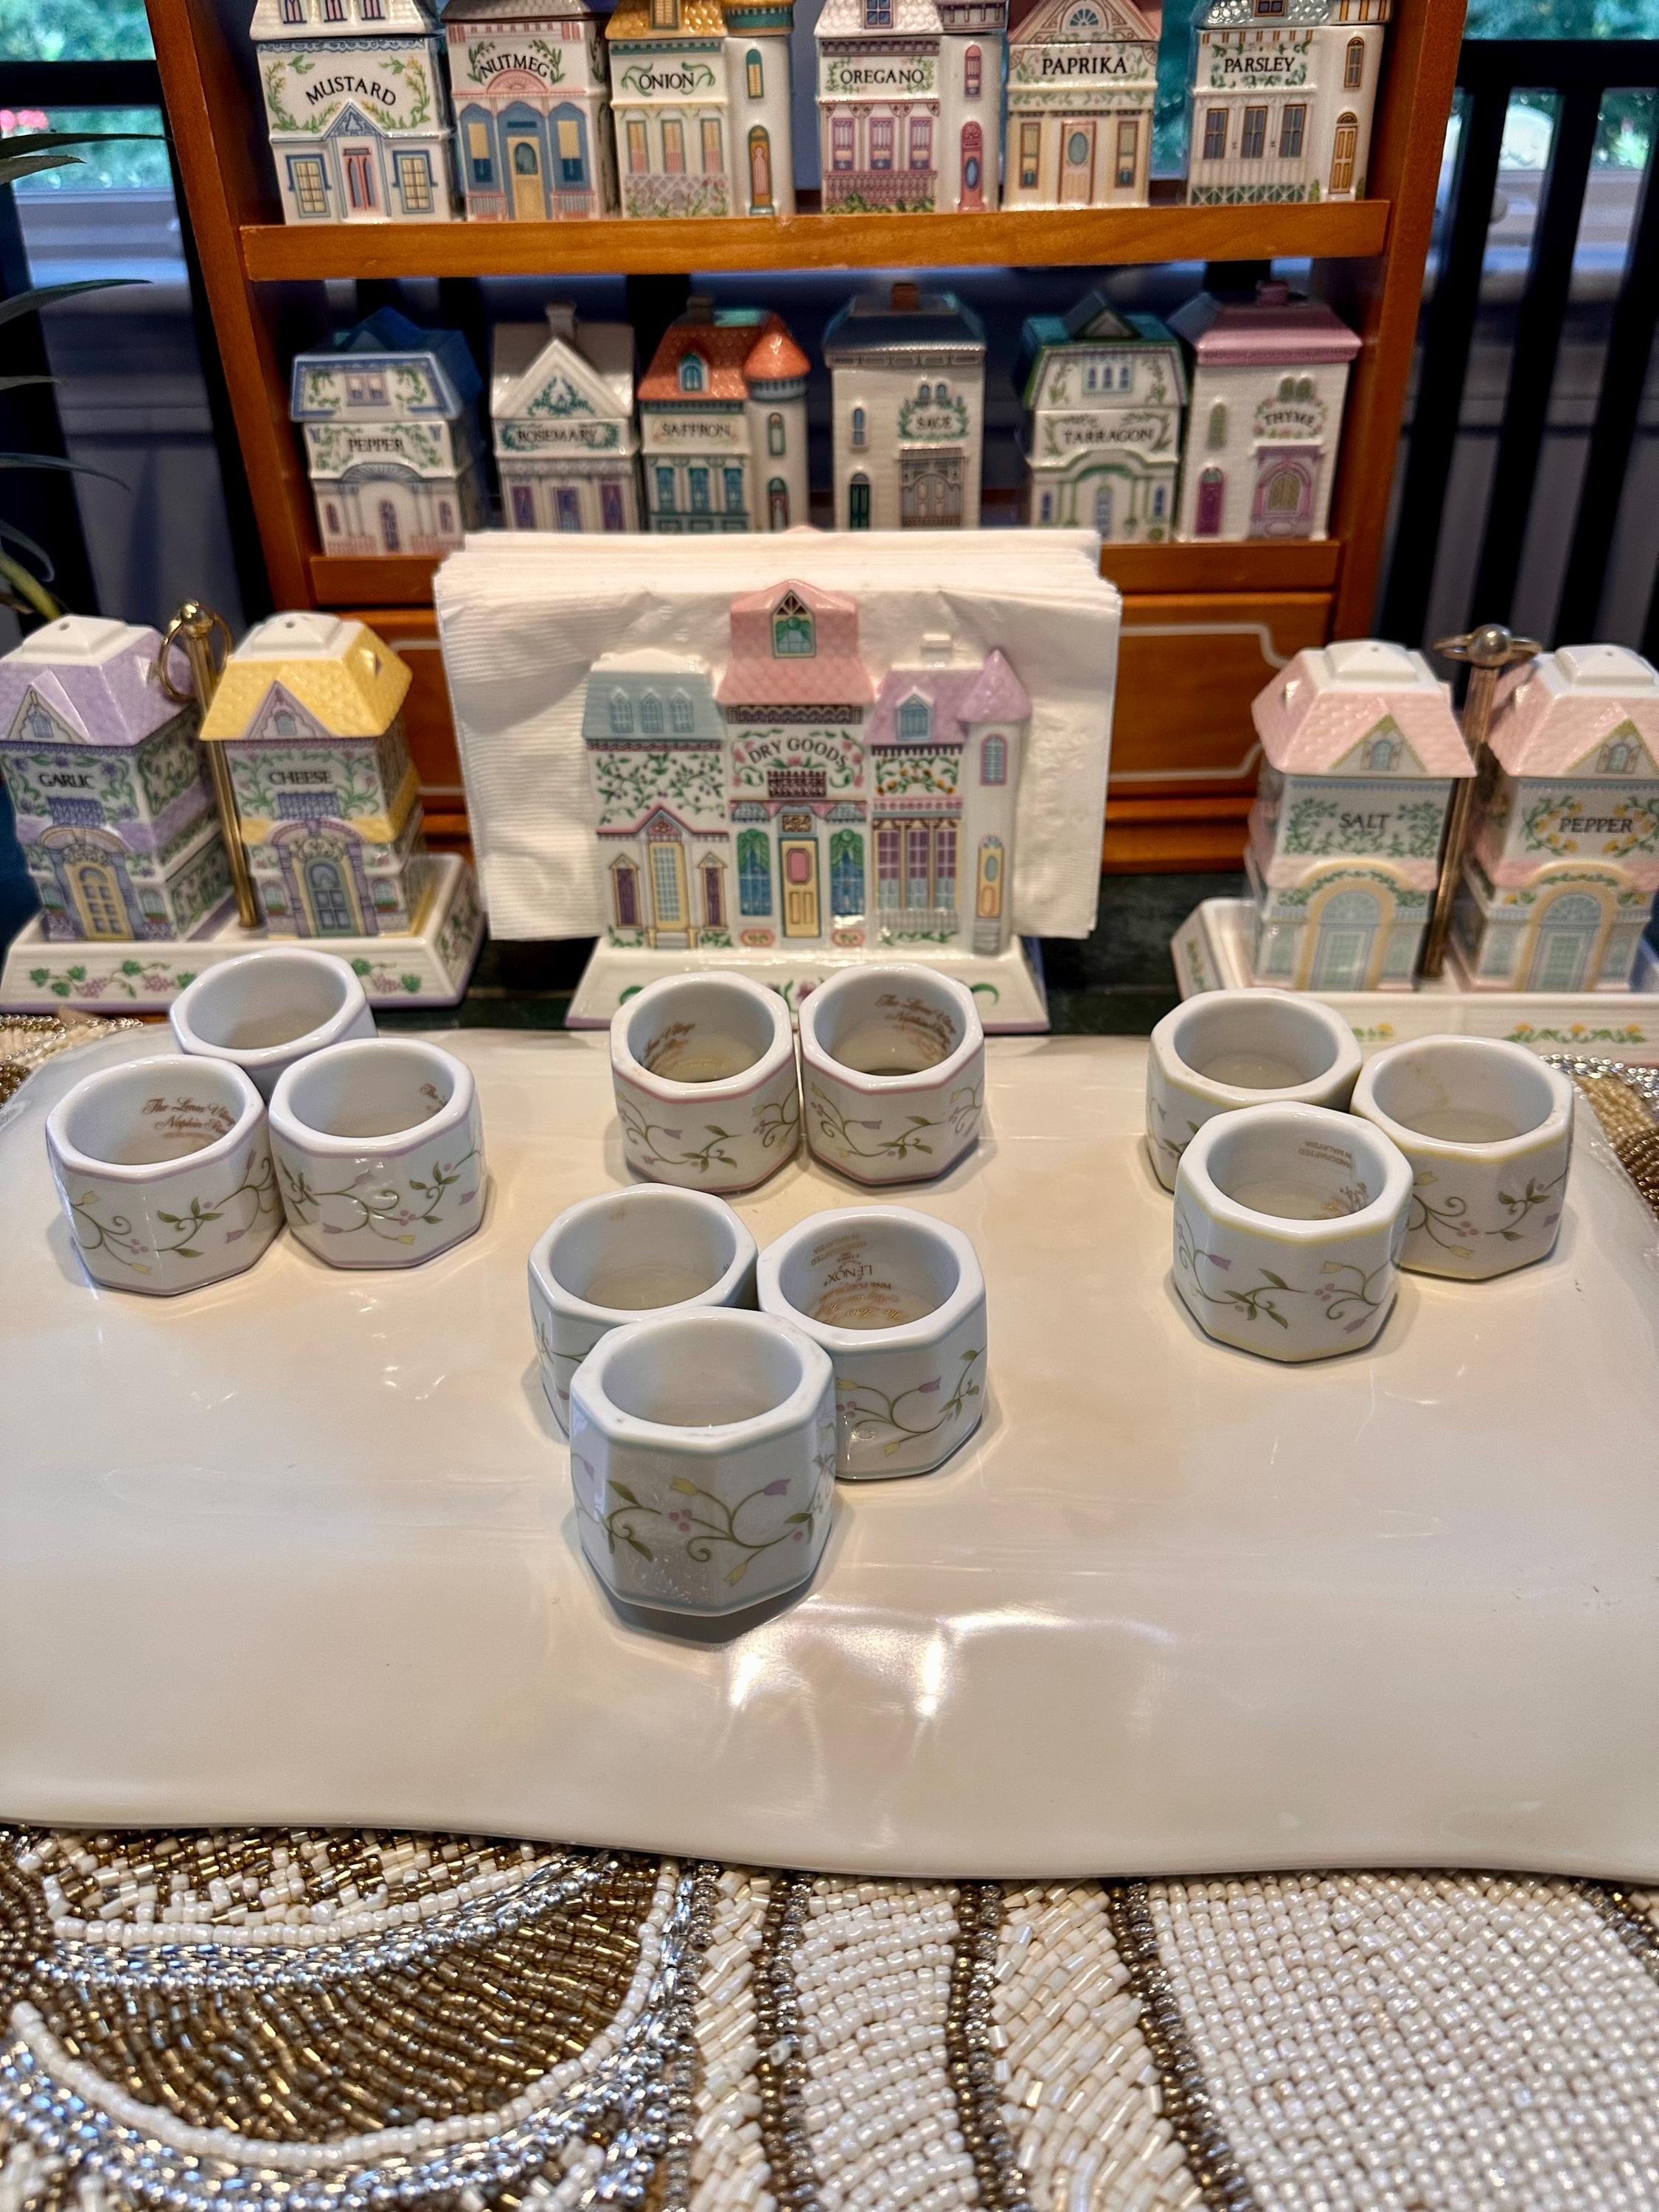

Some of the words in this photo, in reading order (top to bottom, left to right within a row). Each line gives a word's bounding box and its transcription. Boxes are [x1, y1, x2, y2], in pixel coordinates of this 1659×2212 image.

[479, 53, 550, 78] NUTMEG
[1042, 56, 1128, 77] PAPRIKA
[1223, 55, 1296, 74] PARSLEY
[639, 72, 695, 90] ONION
[839, 66, 925, 86] OREGANO
[305, 75, 398, 107] MUSTARD
[916, 415, 953, 430] SAGE
[1265, 410, 1315, 428] THYME
[518, 429, 597, 443] ROSEMARY
[661, 422, 731, 438] SAFFRON
[1064, 427, 1155, 445] TARRAGON
[348, 437, 404, 453] PEPPER
[748, 739, 782, 765] DRY
[786, 737, 851, 768] GOODS
[39, 771, 96, 790] GARLIC
[269, 769, 333, 786] CHEESE
[1338, 813, 1391, 830] SALT
[1559, 817, 1633, 835] PEPPER
[142, 1097, 168, 1115] The
[827, 1264, 873, 1285] LENOX
